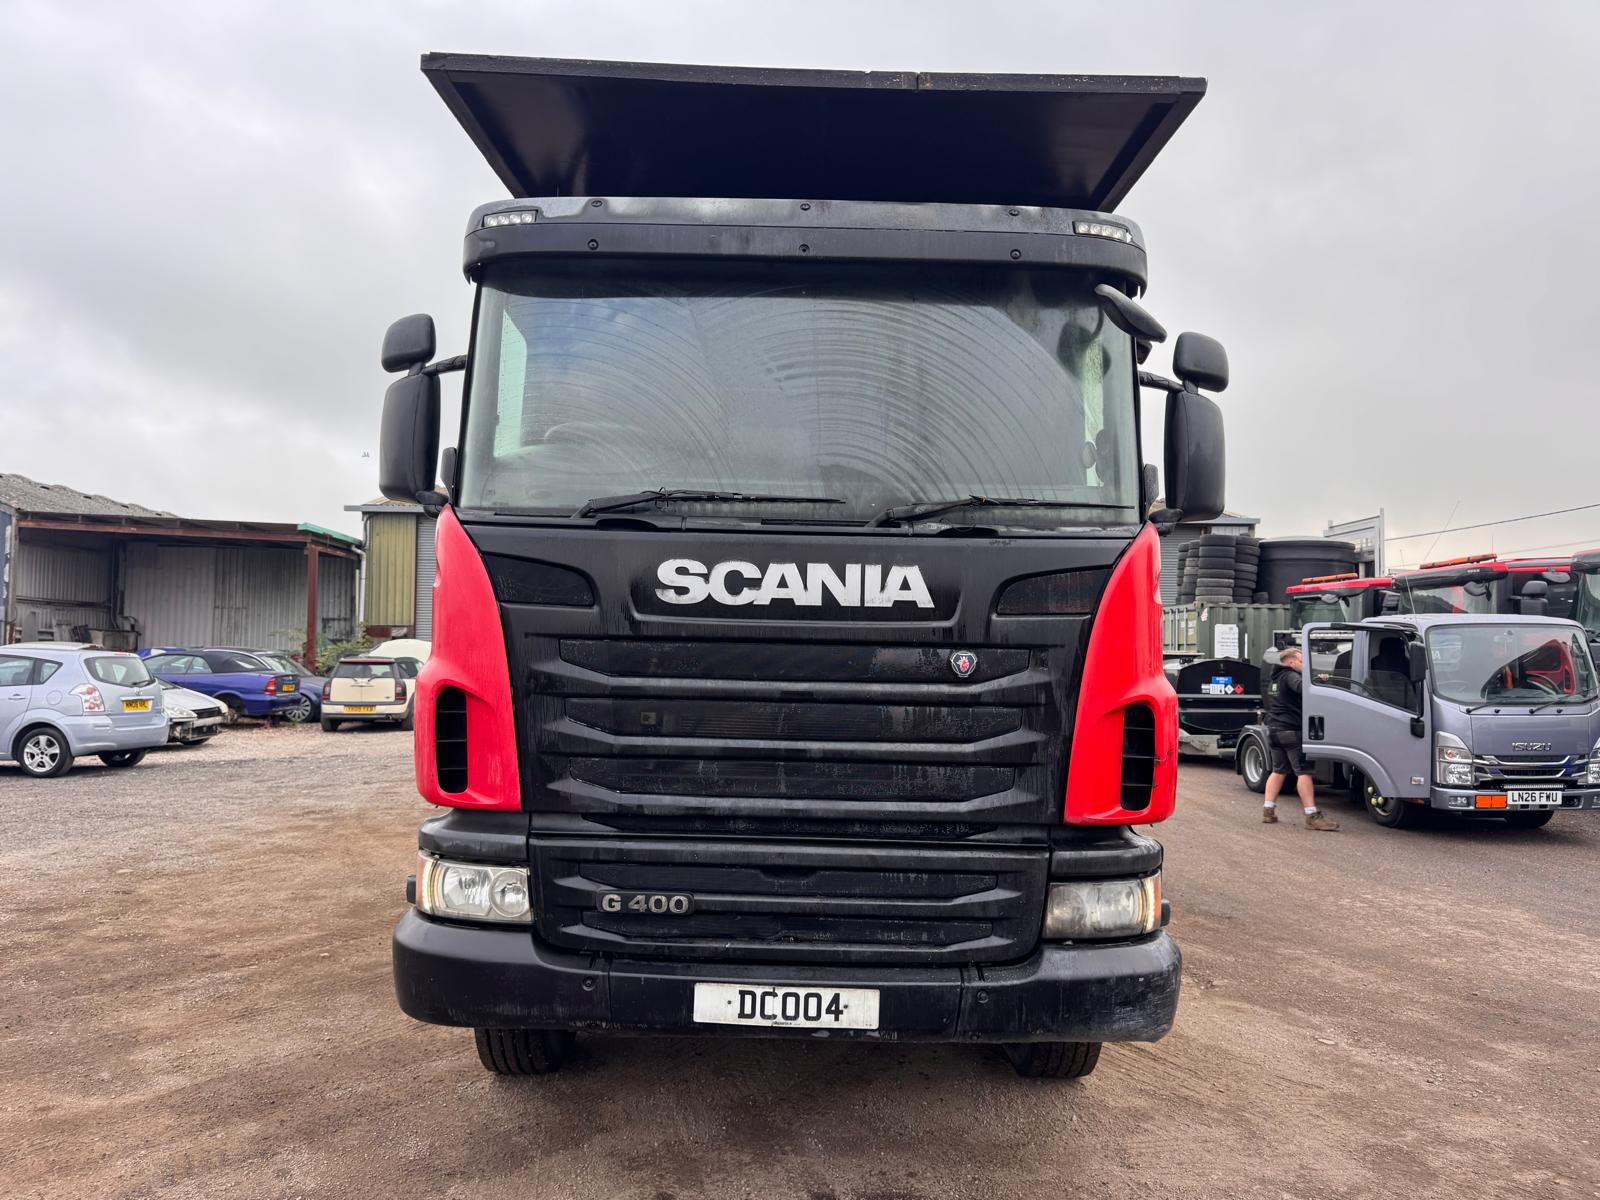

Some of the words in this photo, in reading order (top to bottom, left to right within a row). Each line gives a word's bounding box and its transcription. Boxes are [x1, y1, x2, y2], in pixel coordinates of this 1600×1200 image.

[655, 558, 936, 609] SCANIA
[1511, 742, 1552, 752] ISUZU
[1511, 791, 1537, 802] LN26
[1539, 791, 1558, 802] FWU
[601, 894, 622, 912] G
[627, 894, 689, 914] 400
